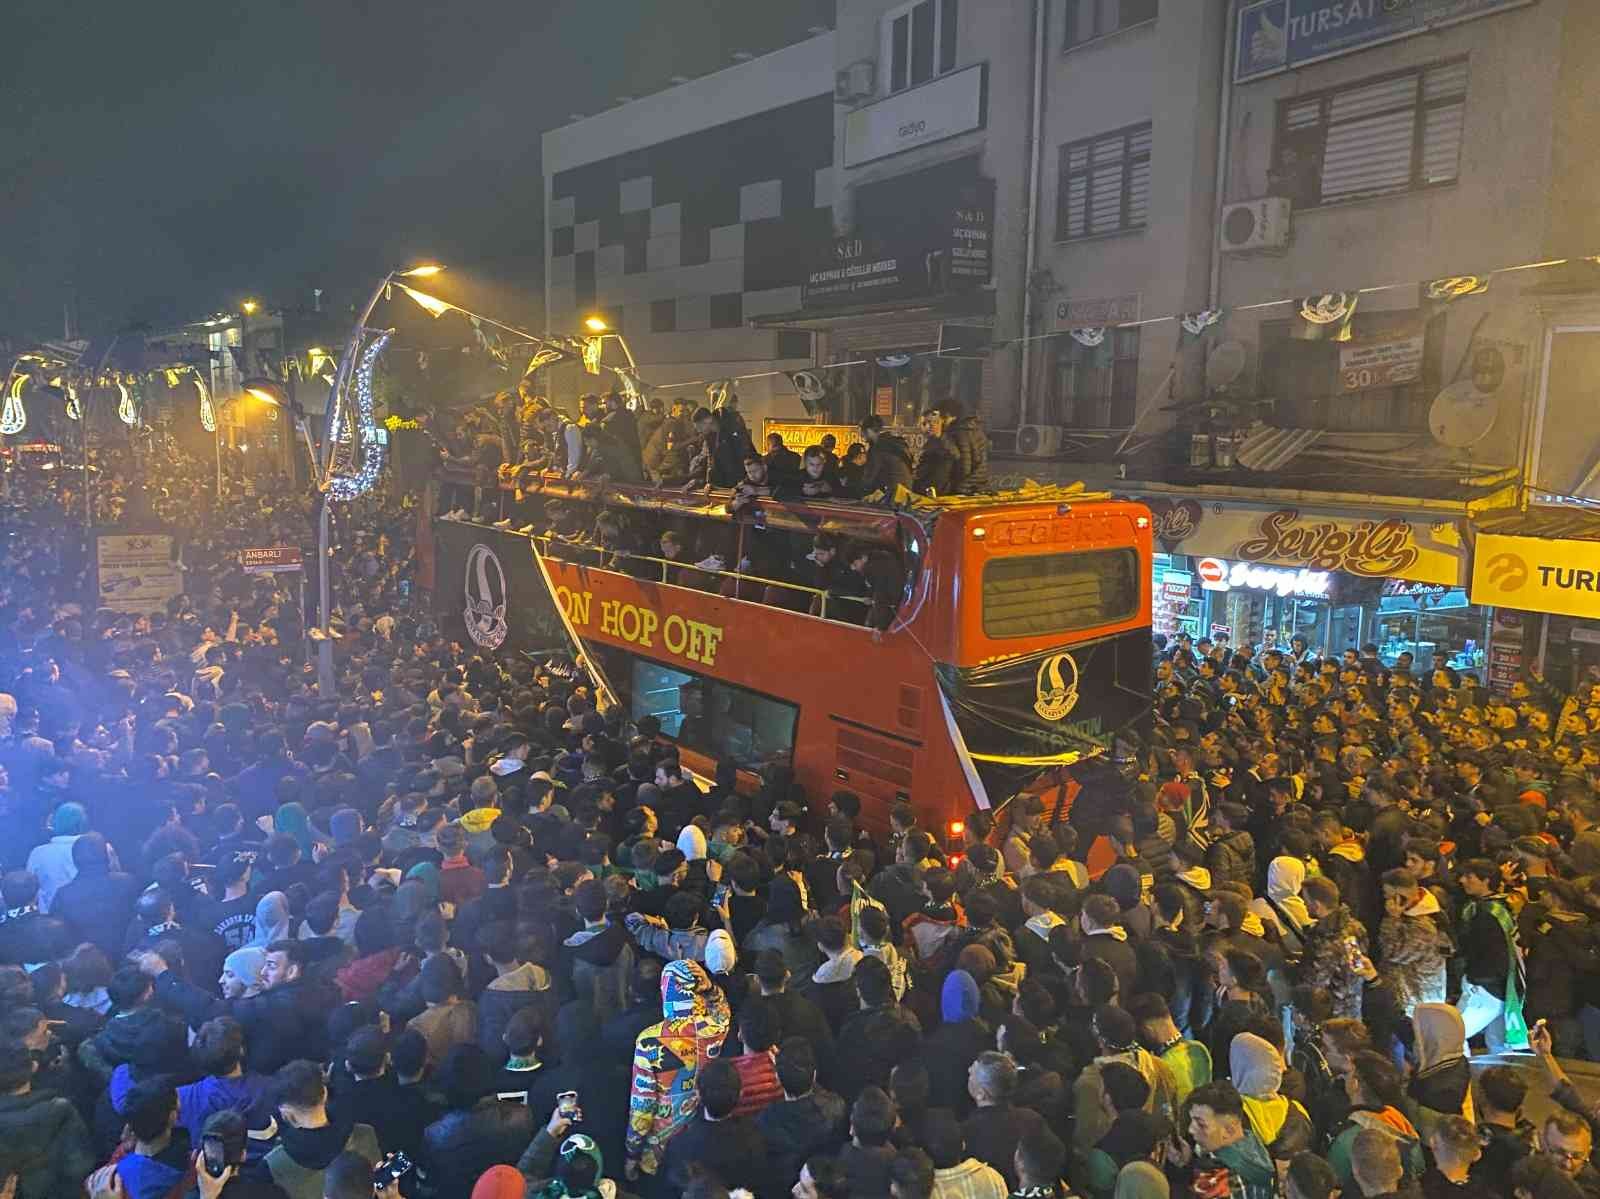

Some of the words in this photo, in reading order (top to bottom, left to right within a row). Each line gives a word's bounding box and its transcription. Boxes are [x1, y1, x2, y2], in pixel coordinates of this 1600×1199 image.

[1237, 509, 1418, 578] Sevgili
[1537, 565, 1600, 595] TUR
[600, 600, 658, 648] HOP
[664, 614, 723, 667] OFF
